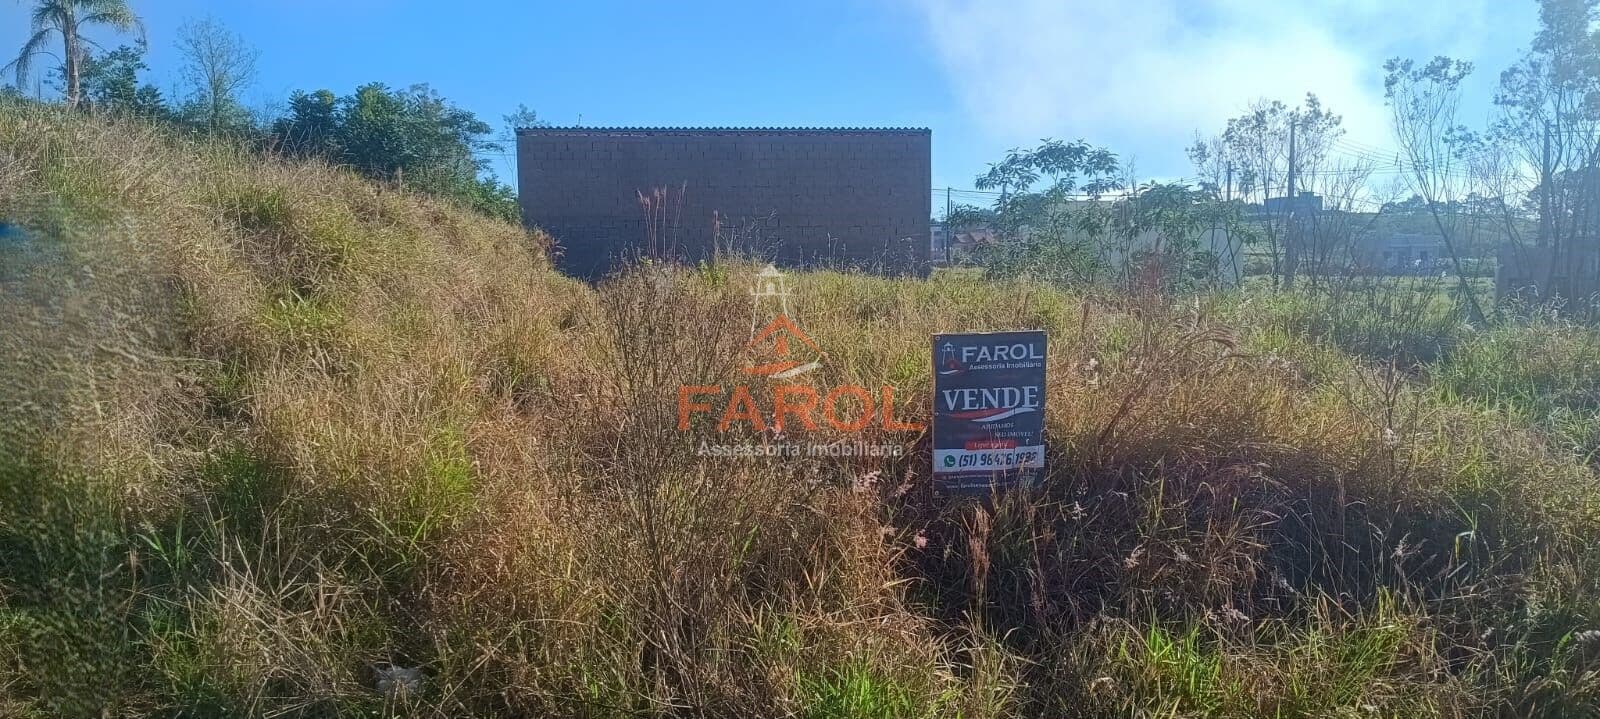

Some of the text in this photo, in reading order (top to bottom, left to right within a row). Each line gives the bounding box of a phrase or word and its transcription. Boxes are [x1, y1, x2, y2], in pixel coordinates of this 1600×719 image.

[961, 343, 1044, 363] FAROL
[968, 363, 1006, 371] Assessoria
[942, 385, 1039, 411] VENDE
[958, 453, 977, 467] (51)
